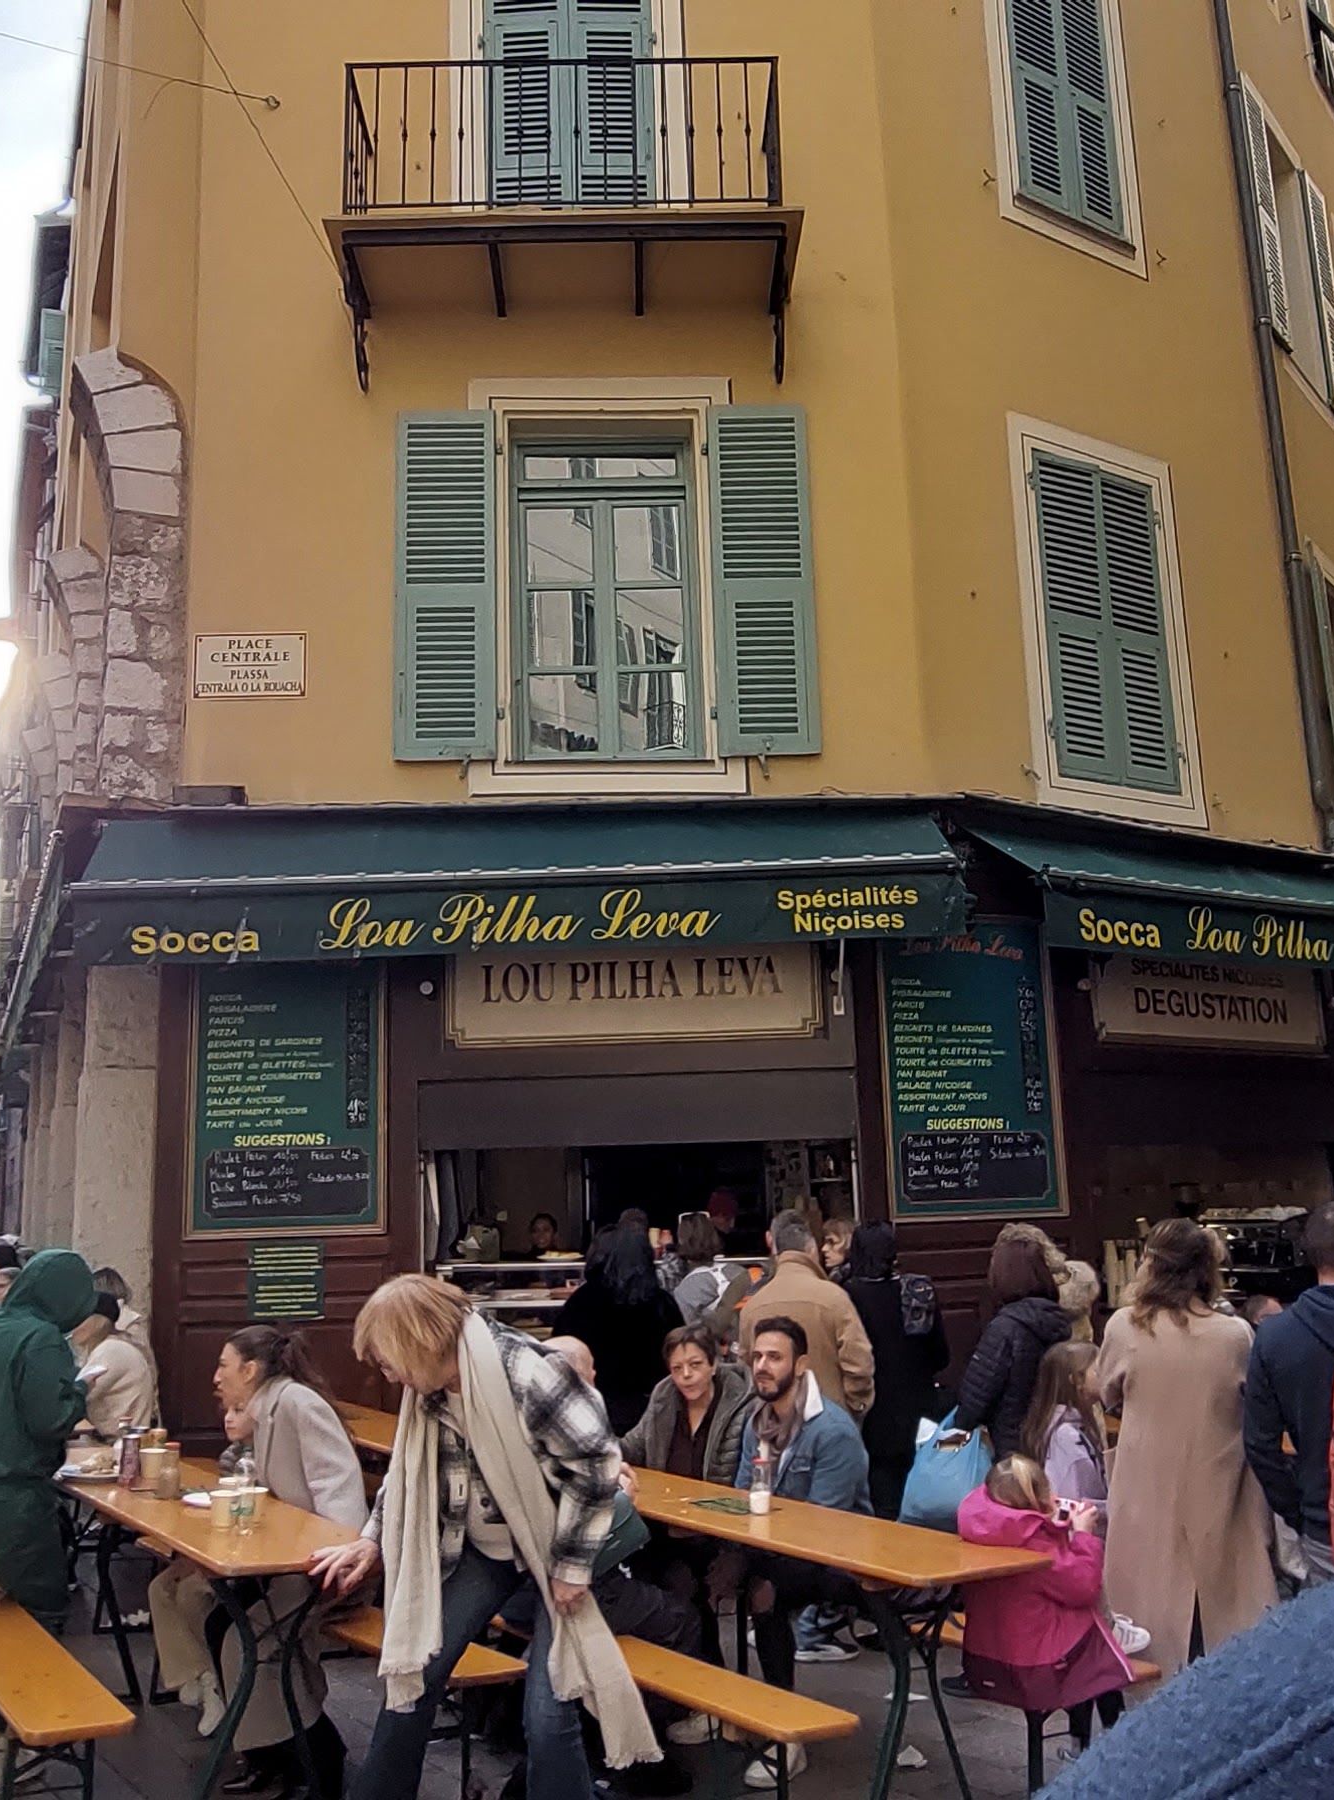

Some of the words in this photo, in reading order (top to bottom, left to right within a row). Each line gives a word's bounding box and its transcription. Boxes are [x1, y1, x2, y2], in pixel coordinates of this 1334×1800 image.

[210, 651, 290, 662] CENTRALE
[228, 639, 273, 649] PLACE
[230, 669, 269, 680] PLASSA
[251, 682, 261, 692] LA
[777, 885, 919, 914] Spécialités
[319, 898, 426, 949] Lou
[432, 893, 585, 946] Pilha
[590, 888, 721, 940] Leva
[793, 910, 905, 936] Niçoises
[1079, 908, 1161, 949] Socca
[131, 926, 260, 954] Socca
[1186, 906, 1248, 953] Lou
[1252, 914, 1334, 961] Pilha
[481, 961, 556, 1003] LOU
[569, 959, 683, 1000] PILHA
[694, 954, 784, 996] LEVA
[1131, 957, 1220, 983] SPECIALITES
[1134, 986, 1288, 1024] DEGUSTATION
[207, 1028, 238, 1037] PIZZA
[926, 1117, 1004, 1131] SUGGESTIONS
[233, 1133, 325, 1148] SUGGESTIONS
